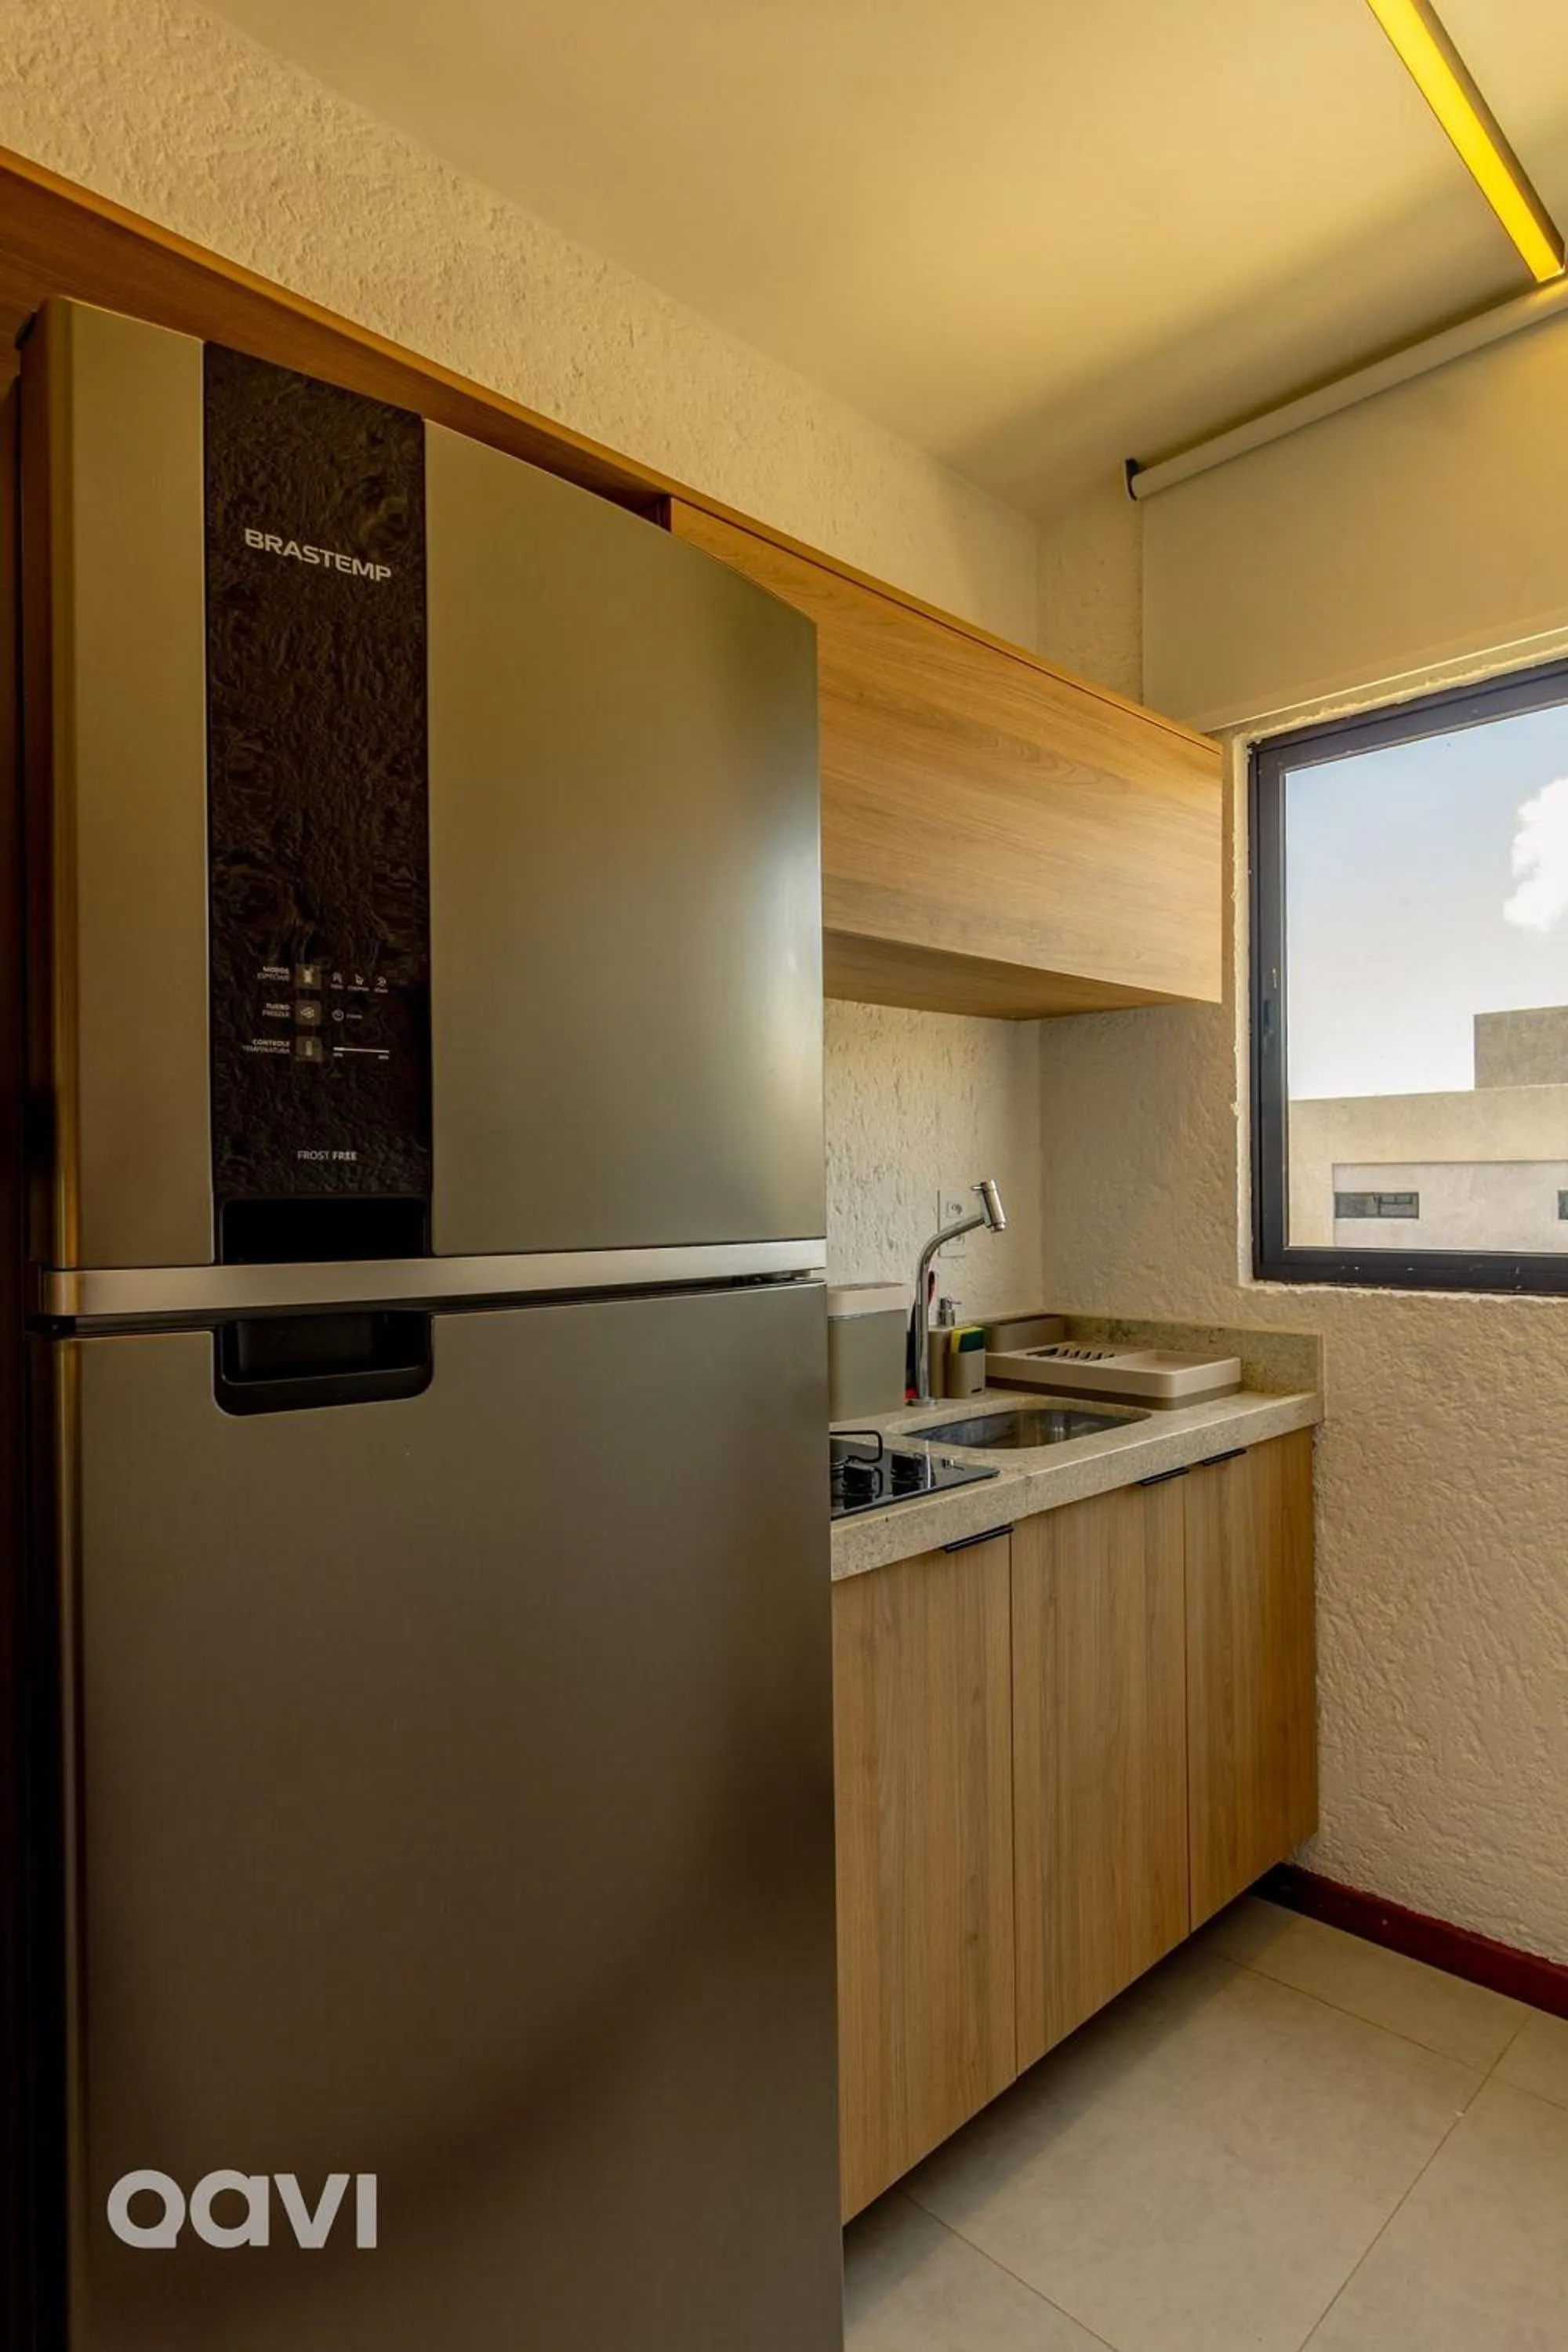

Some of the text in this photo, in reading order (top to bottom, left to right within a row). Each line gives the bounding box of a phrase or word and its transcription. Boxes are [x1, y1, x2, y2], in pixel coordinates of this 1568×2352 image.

[245, 528, 392, 581] BRASTEMP
[297, 1150, 358, 1161] FROST FREE
